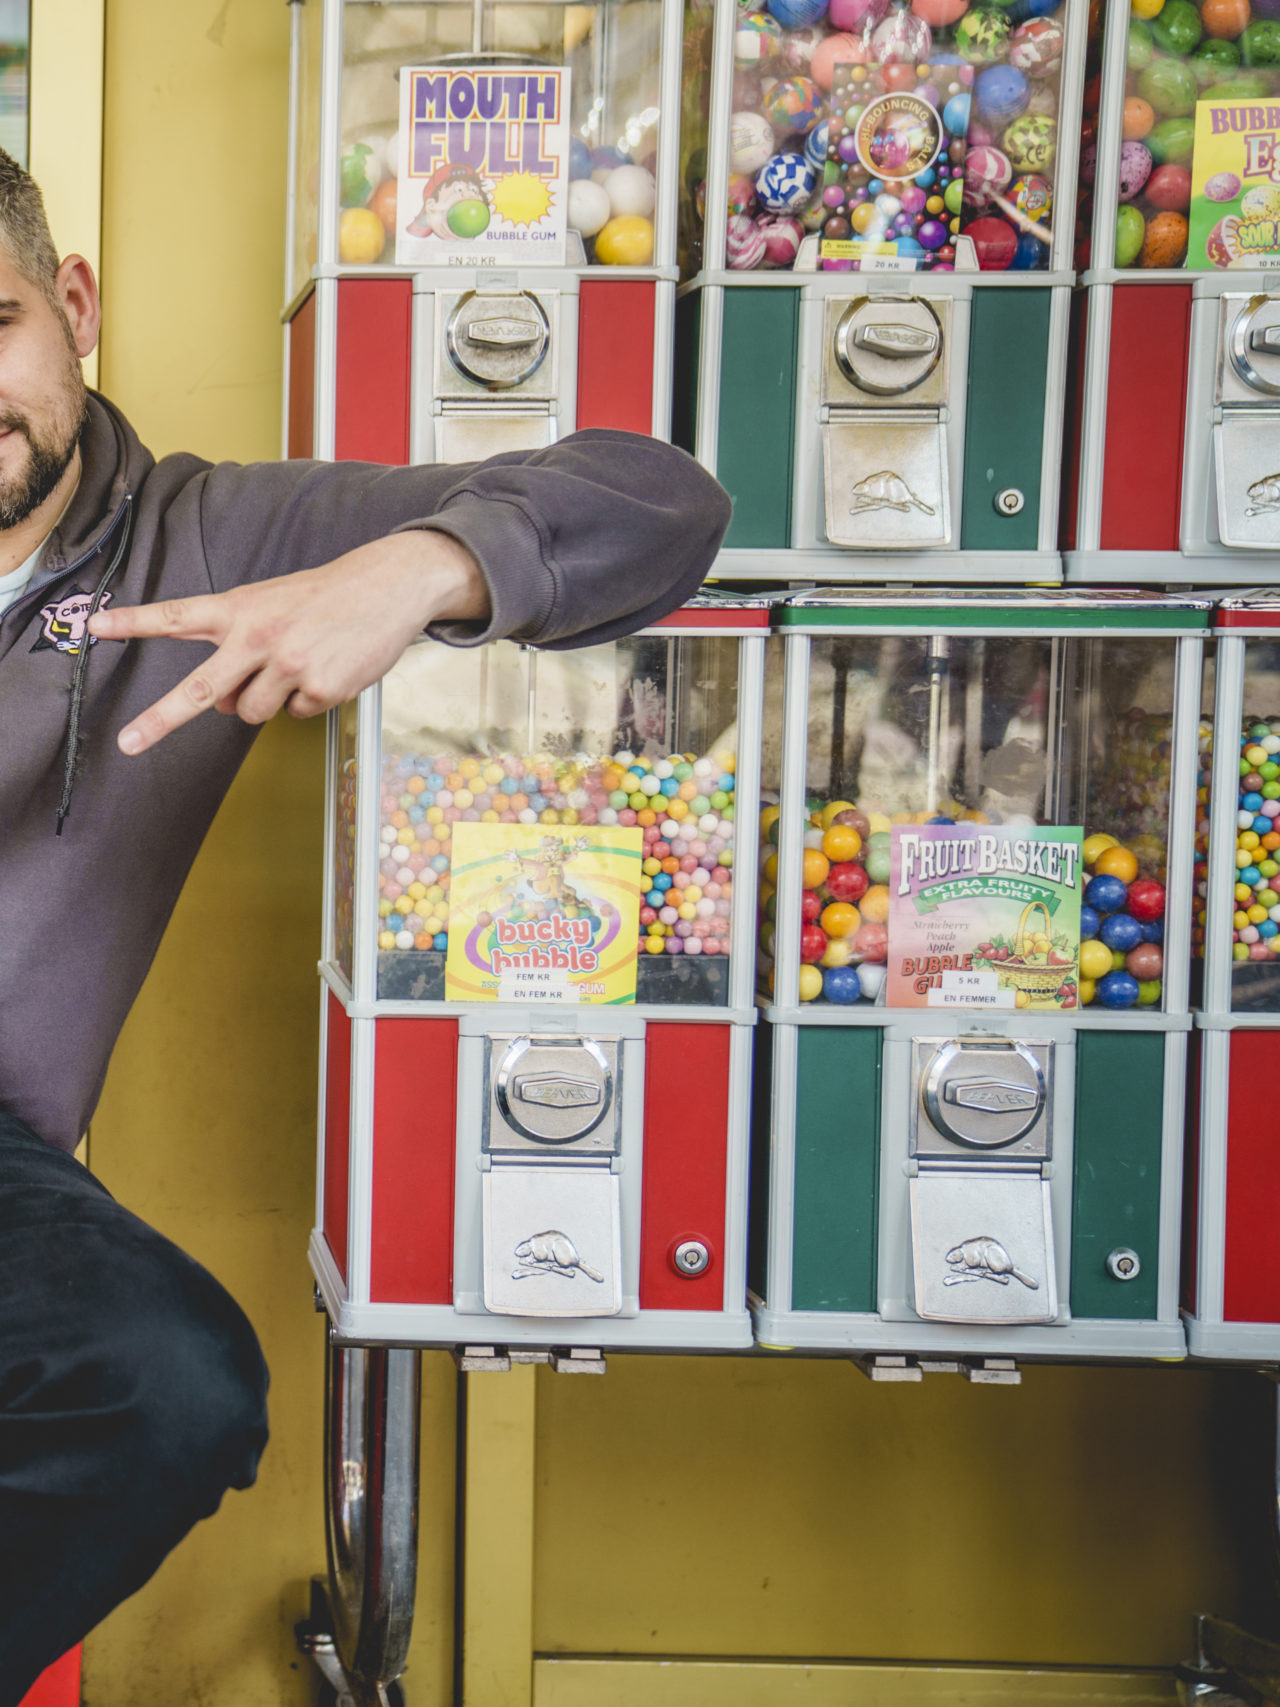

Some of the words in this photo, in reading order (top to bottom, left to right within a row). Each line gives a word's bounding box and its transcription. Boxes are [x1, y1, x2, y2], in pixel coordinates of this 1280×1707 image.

[413, 74, 558, 121] MOUTH
[861, 99, 929, 141] HI-BOUNCING
[411, 121, 557, 175] FULL
[906, 136, 934, 171] BALLS
[486, 231, 528, 241] BUBBLE
[531, 231, 557, 241] GUM
[1237, 220, 1275, 249] SOUR
[448, 255, 463, 265] EN
[465, 256, 478, 266] 20
[481, 256, 496, 266] KR
[898, 834, 975, 896] FRUIT
[977, 834, 1080, 889] BASKET
[924, 878, 982, 897] EXTRA
[987, 878, 1052, 898] FRUITY
[942, 886, 1033, 901] FLAVOURS
[495, 913, 592, 946] bucky
[926, 931, 957, 941] Peach
[926, 942, 955, 953] Apple
[491, 945, 599, 976] bubble
[901, 953, 974, 976] BUBBLE
[517, 973, 534, 981] FEM
[537, 973, 550, 981] KR
[913, 975, 943, 995] GU
[958, 977, 964, 985] 5
[967, 977, 980, 985] KR
[514, 990, 526, 998] EN
[529, 990, 547, 998] FEM
[550, 991, 563, 999] KR
[959, 995, 996, 1004] FEMMER
